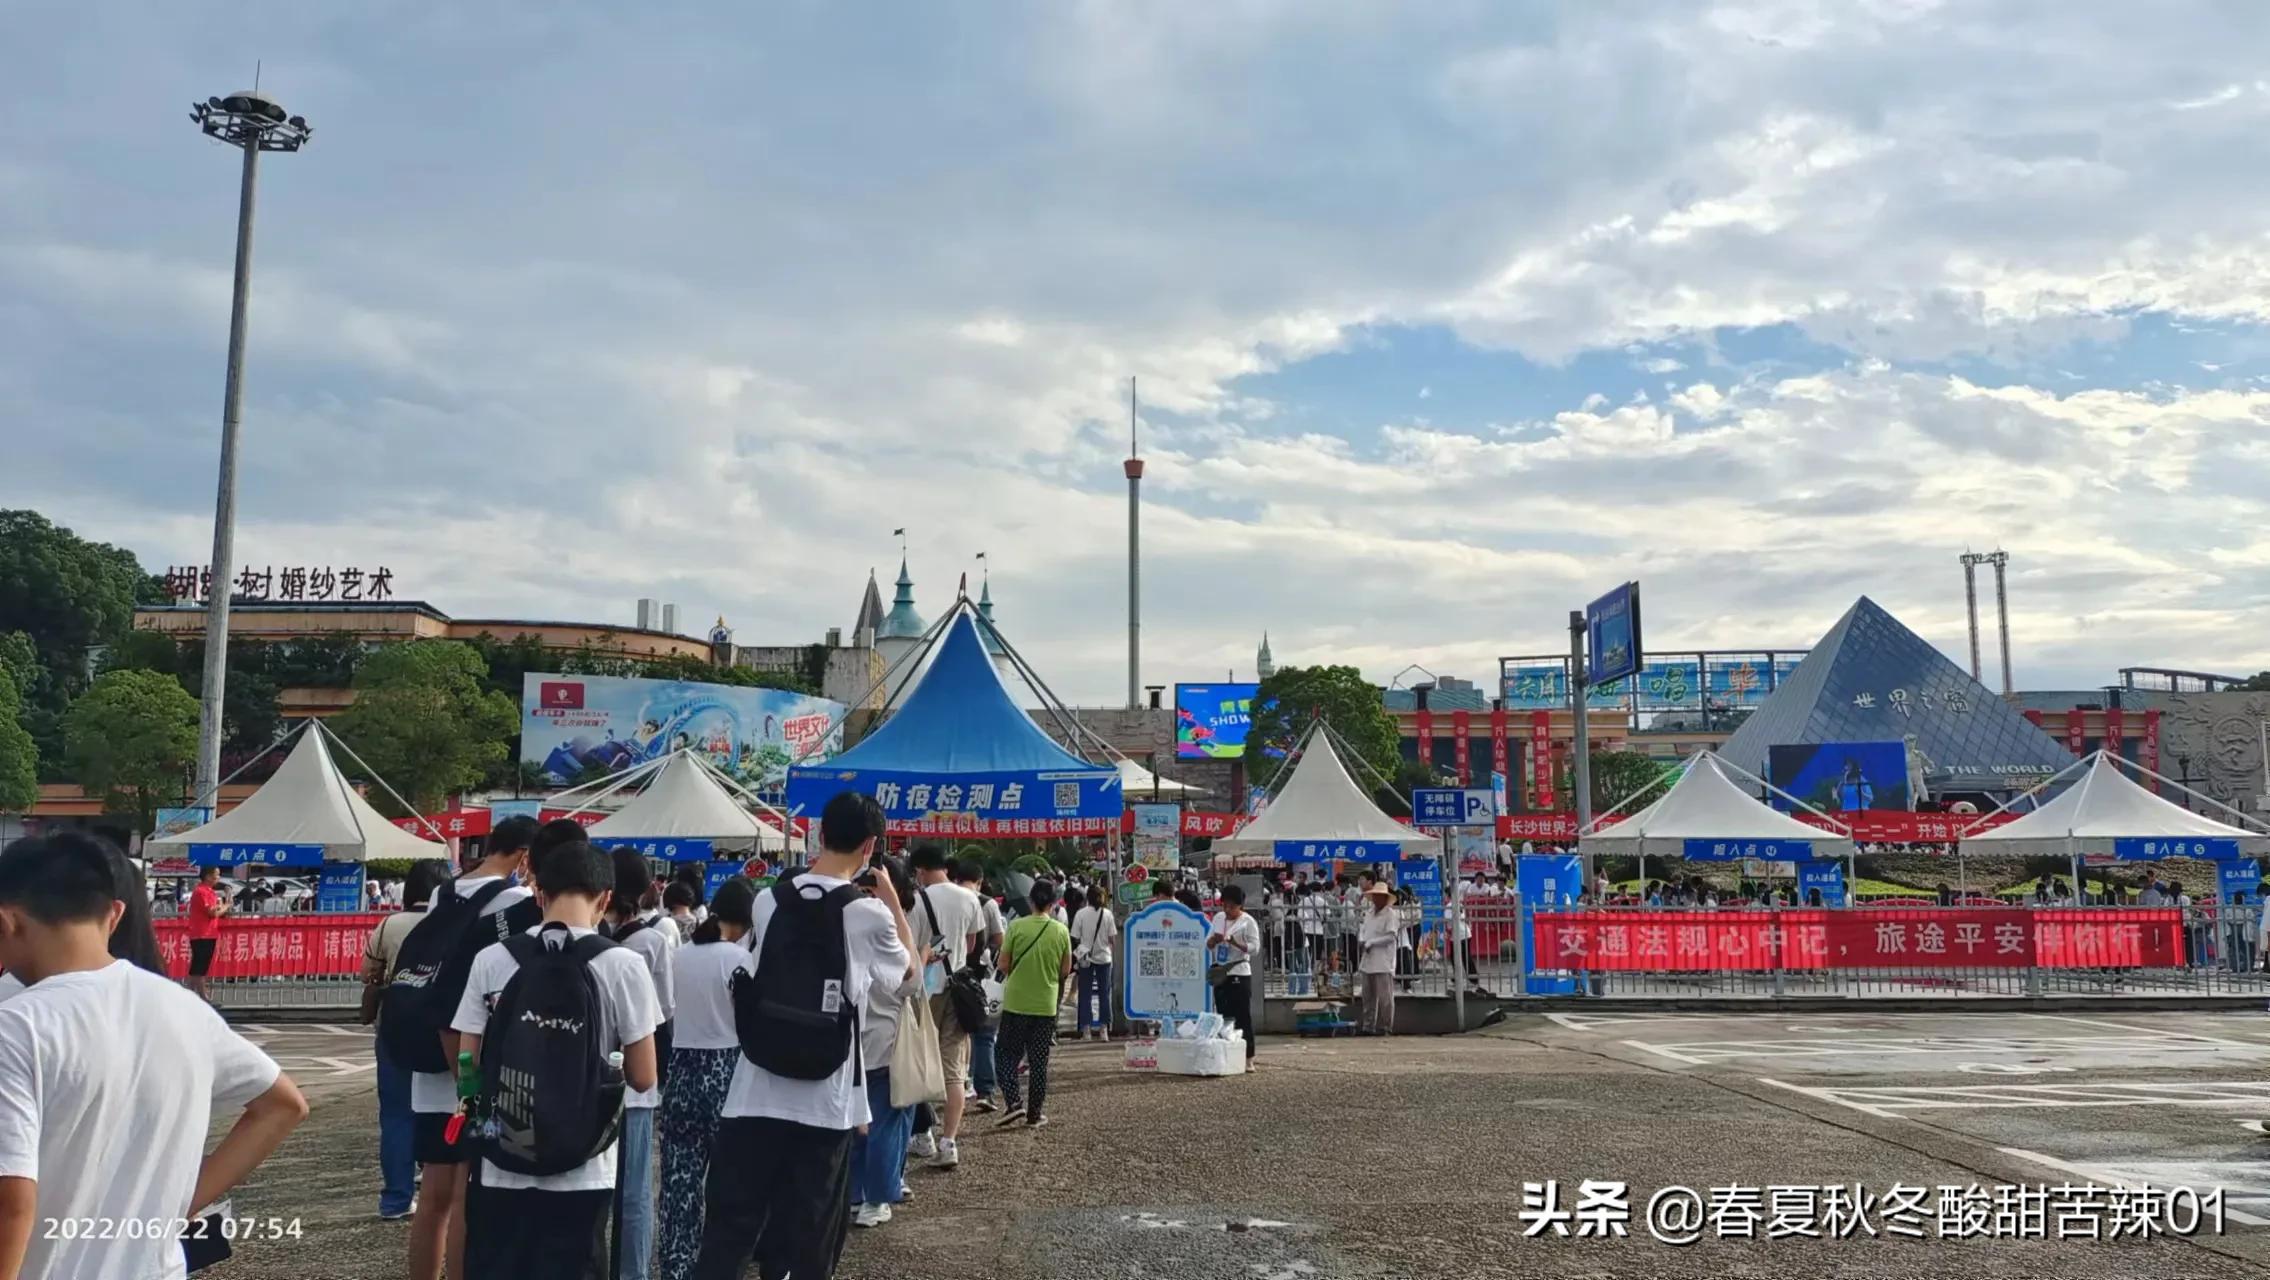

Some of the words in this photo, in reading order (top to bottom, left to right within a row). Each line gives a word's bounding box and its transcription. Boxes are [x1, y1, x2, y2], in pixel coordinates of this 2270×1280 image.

[1945, 765, 1985, 775] THE
[1991, 764, 2055, 774] WORLD
[875, 783, 1024, 810] 防疫检测点
[1425, 806, 1455, 816] 停车位
[1467, 797, 1481, 817] P
[1917, 823, 1948, 838] 开始
